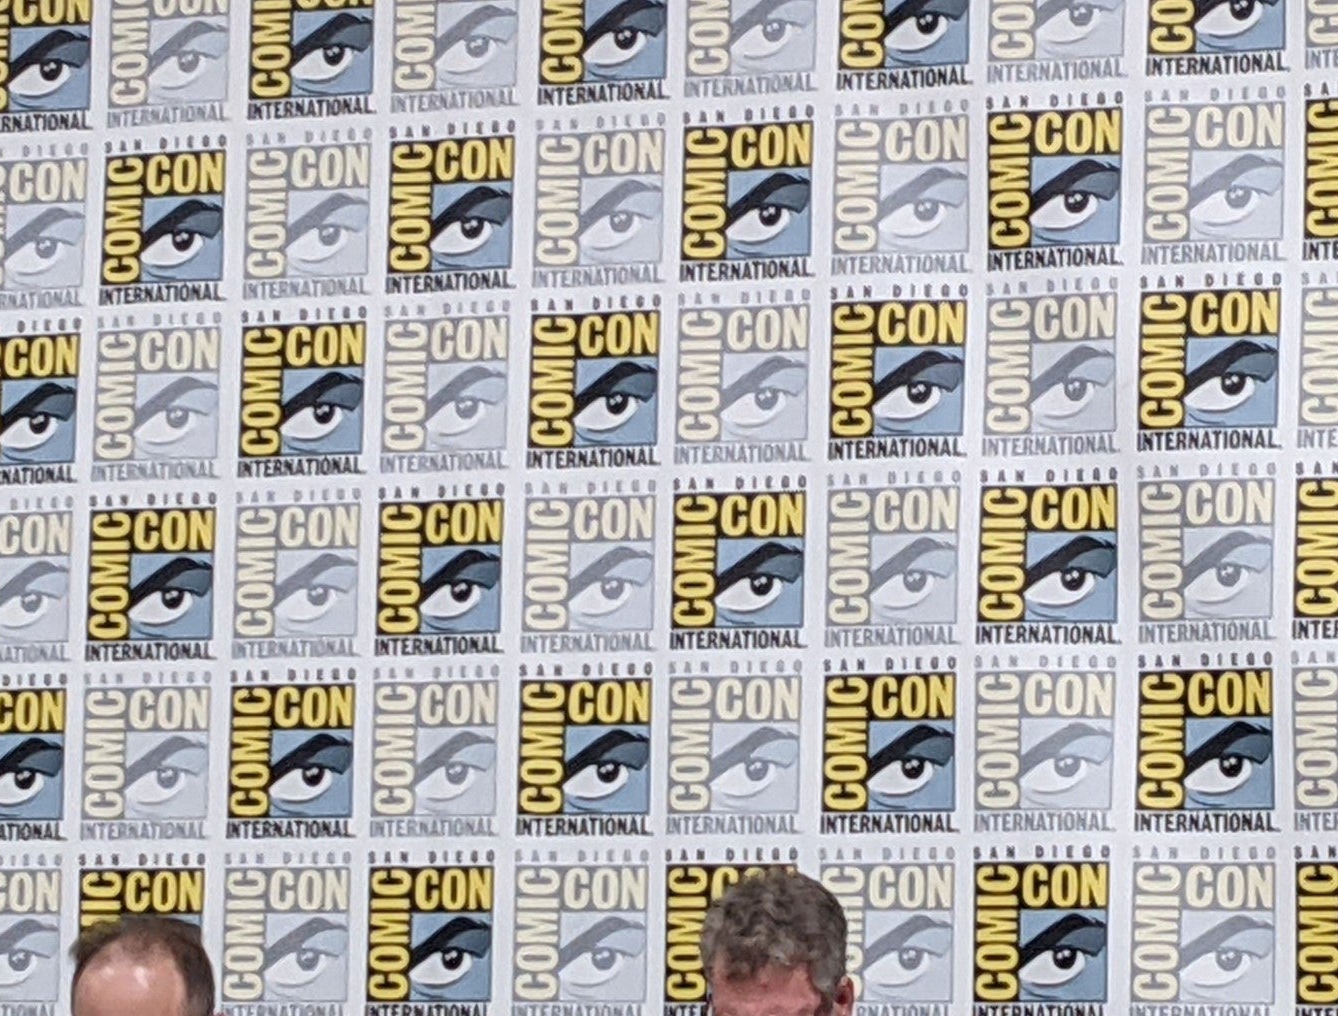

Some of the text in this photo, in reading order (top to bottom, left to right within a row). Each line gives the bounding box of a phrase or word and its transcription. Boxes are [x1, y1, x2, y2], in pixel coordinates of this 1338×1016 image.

[106, 136, 225, 153] SAN DIEGO
[390, 121, 514, 138] SAN DIEGO
[146, 156, 225, 195] CON
[435, 140, 513, 181] CON
[105, 160, 144, 282] COMIC
[388, 146, 433, 271] COMIC
[100, 284, 225, 305] INTERNATIONAL
[386, 271, 514, 293] INTERNATIONAL
[831, 286, 967, 299] SAN DIEGO
[19, 319, 80, 332] DIEGO
[878, 305, 966, 344] CON
[4, 336, 78, 377] CON
[830, 306, 875, 436] COMIC
[829, 438, 965, 460] INTERNATIONAL
[91, 493, 215, 506] SAN DIEGO
[674, 476, 806, 490] SAN DIEGO
[134, 511, 215, 551] CON
[721, 495, 805, 536] CON
[87, 512, 131, 639] COMIC
[672, 494, 718, 626] COMIC
[85, 642, 216, 661] INTERNATIONAL
[670, 630, 807, 649] INTERNATIONAL
[1139, 652, 1271, 667] SAN DIEGO
[1188, 672, 1272, 715] CON
[1139, 673, 1185, 809] COMIC
[1135, 812, 1279, 832] INTERNATIONAL
[369, 851, 494, 863] SAN DIEGO
[415, 868, 493, 910] CON
[366, 867, 412, 999] COMIC
